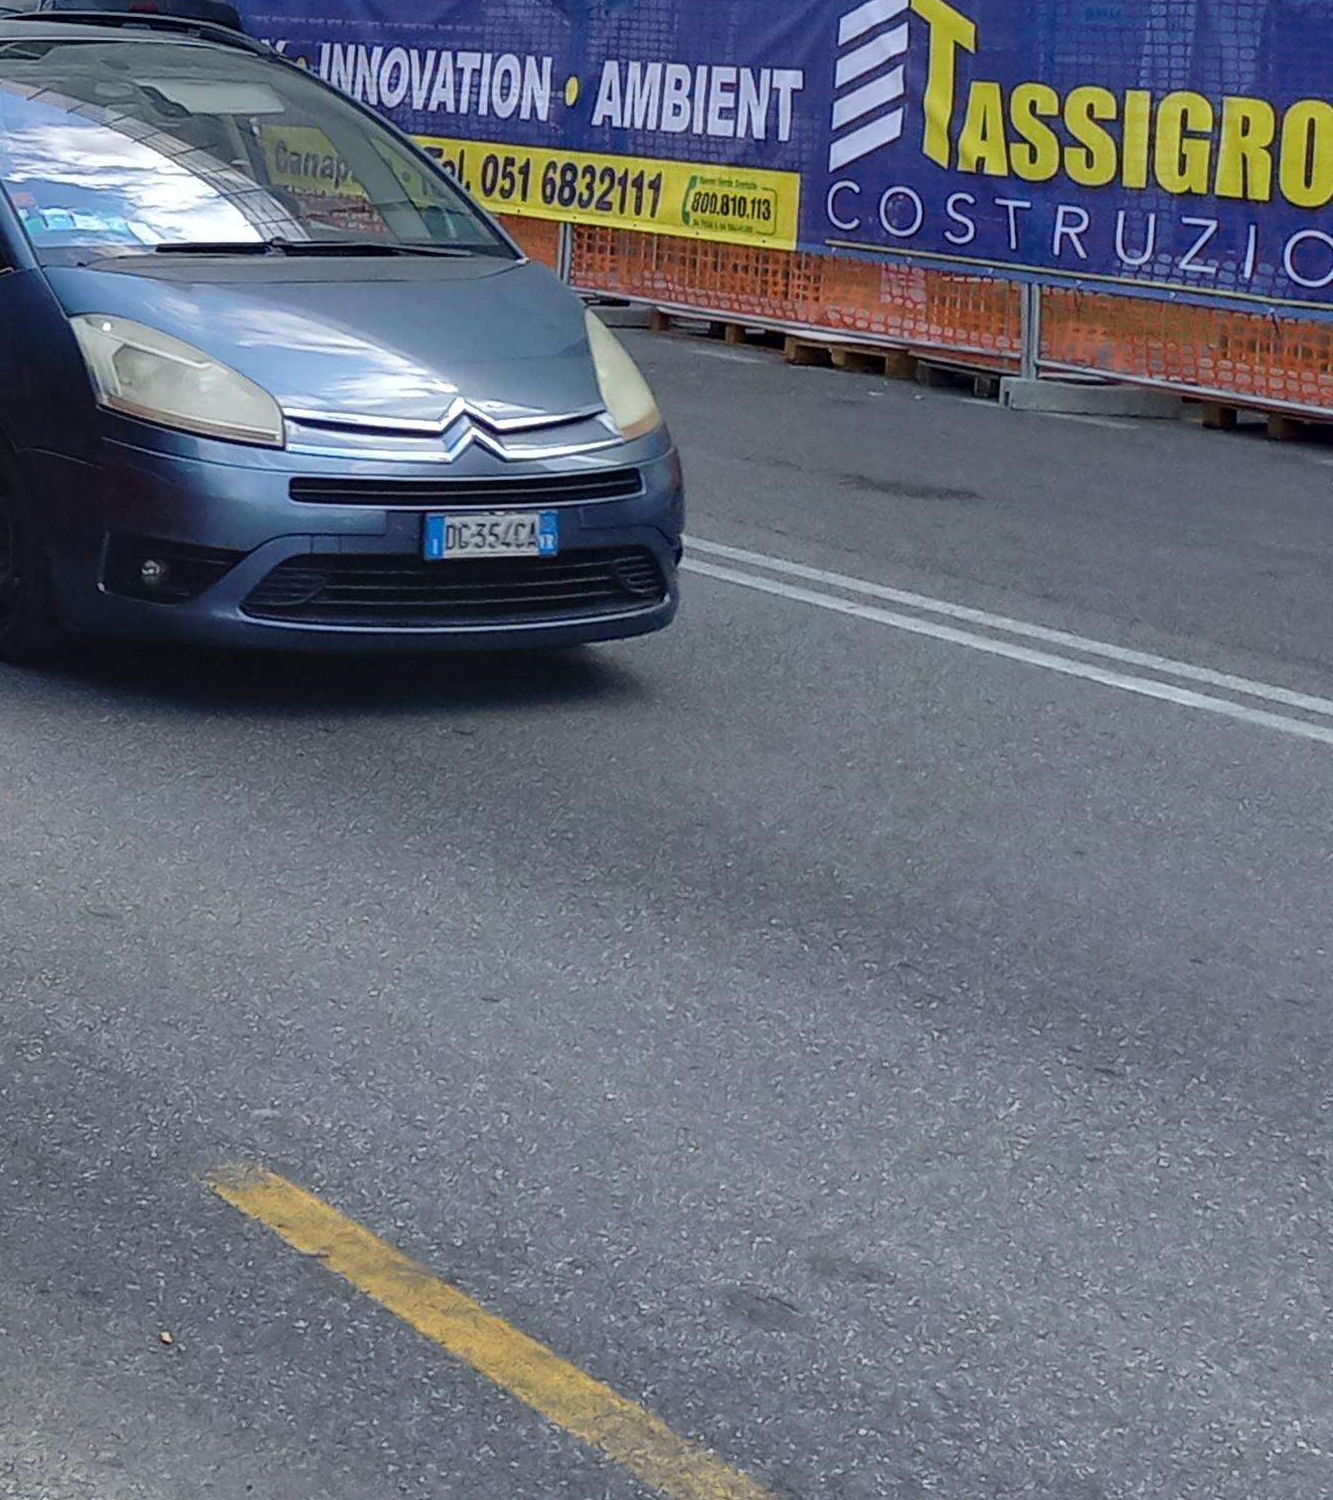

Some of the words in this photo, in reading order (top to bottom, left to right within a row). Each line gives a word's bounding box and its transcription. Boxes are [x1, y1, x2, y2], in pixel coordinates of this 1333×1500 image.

[318, 42, 553, 121] INNOVATION
[592, 60, 804, 142] AMBIENT
[481, 153, 531, 202] 051
[541, 160, 663, 219] 6832111
[691, 191, 771, 221] 800.810.113
[827, 180, 1333, 288] COSTRUZIO
